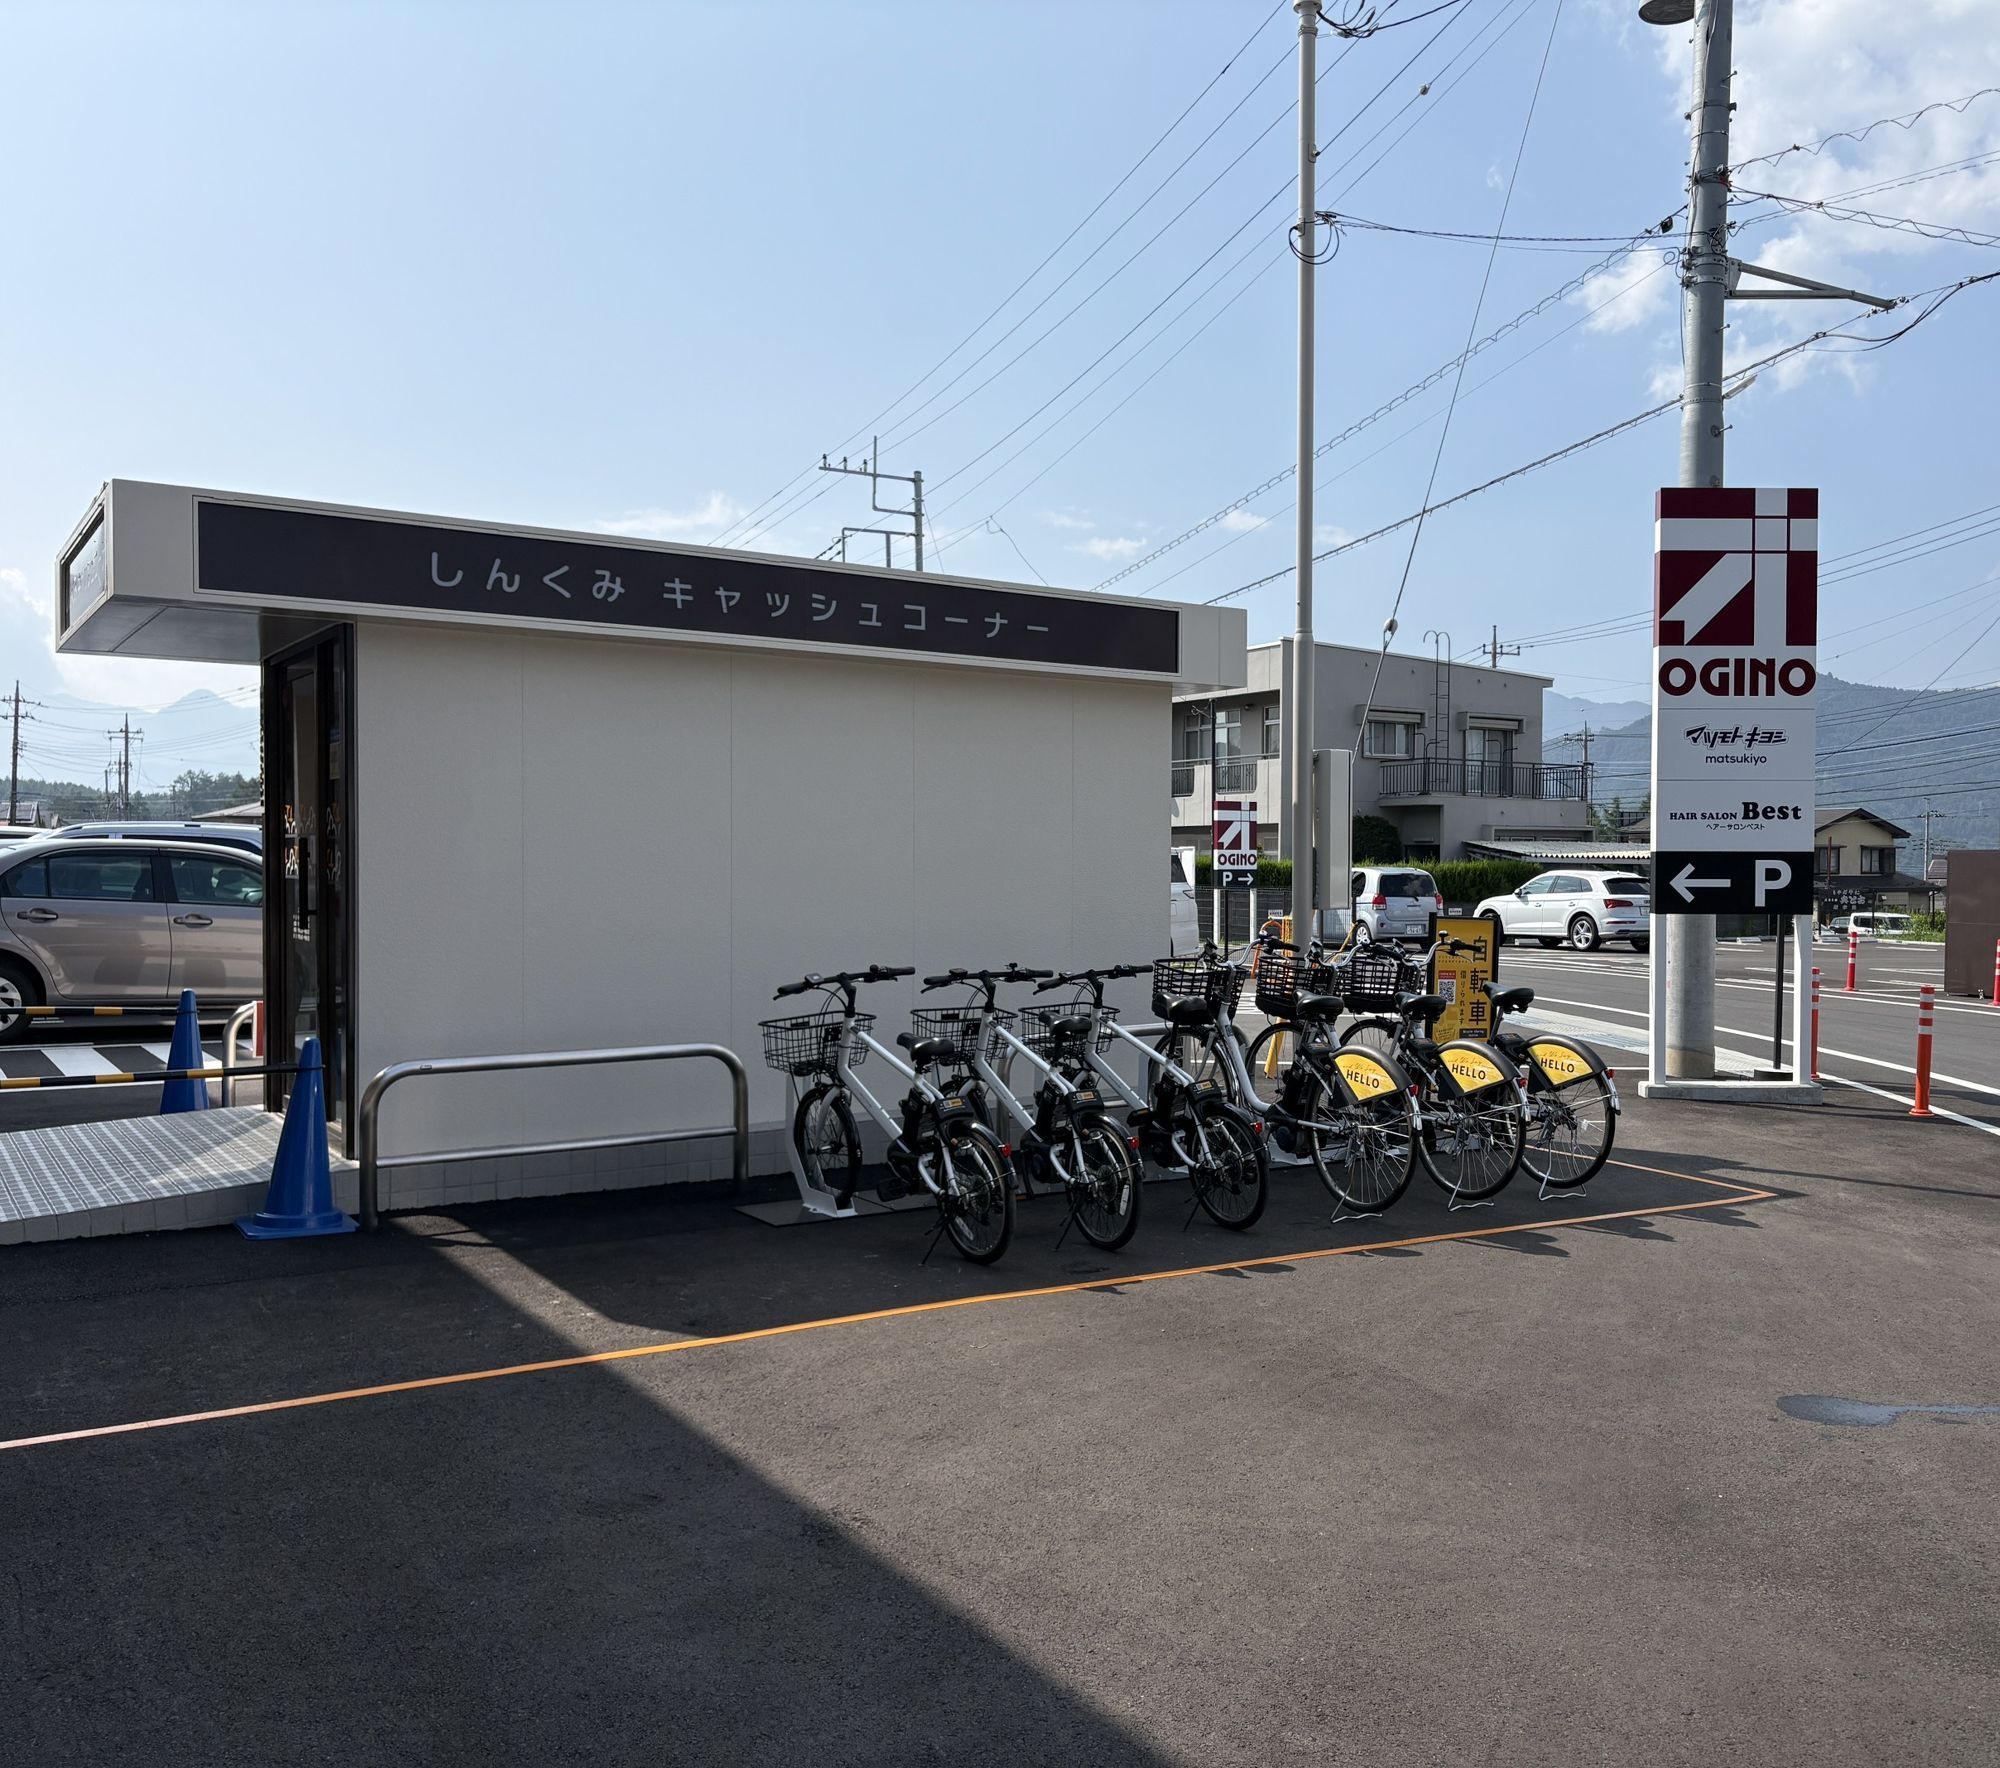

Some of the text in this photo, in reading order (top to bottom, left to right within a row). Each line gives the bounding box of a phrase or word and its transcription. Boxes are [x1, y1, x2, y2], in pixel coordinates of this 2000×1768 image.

[431, 550, 1050, 639] しんくみ キャッシュコーナー
[1659, 658, 1816, 696] OGINO
[1705, 753, 1767, 766] matsukiyo
[1669, 801, 1802, 821] HAIR SALON Best
[1705, 823, 1766, 831] ヘアーサロンベスト
[1217, 853, 1257, 866] OGINO
[1222, 871, 1233, 887] P
[1753, 859, 1793, 908] P
[1468, 935, 1489, 1026] 自転車
[1451, 1063, 1486, 1080] HELLO
[1540, 1057, 1575, 1073] HELLO
[1346, 1069, 1380, 1089] HELLO
